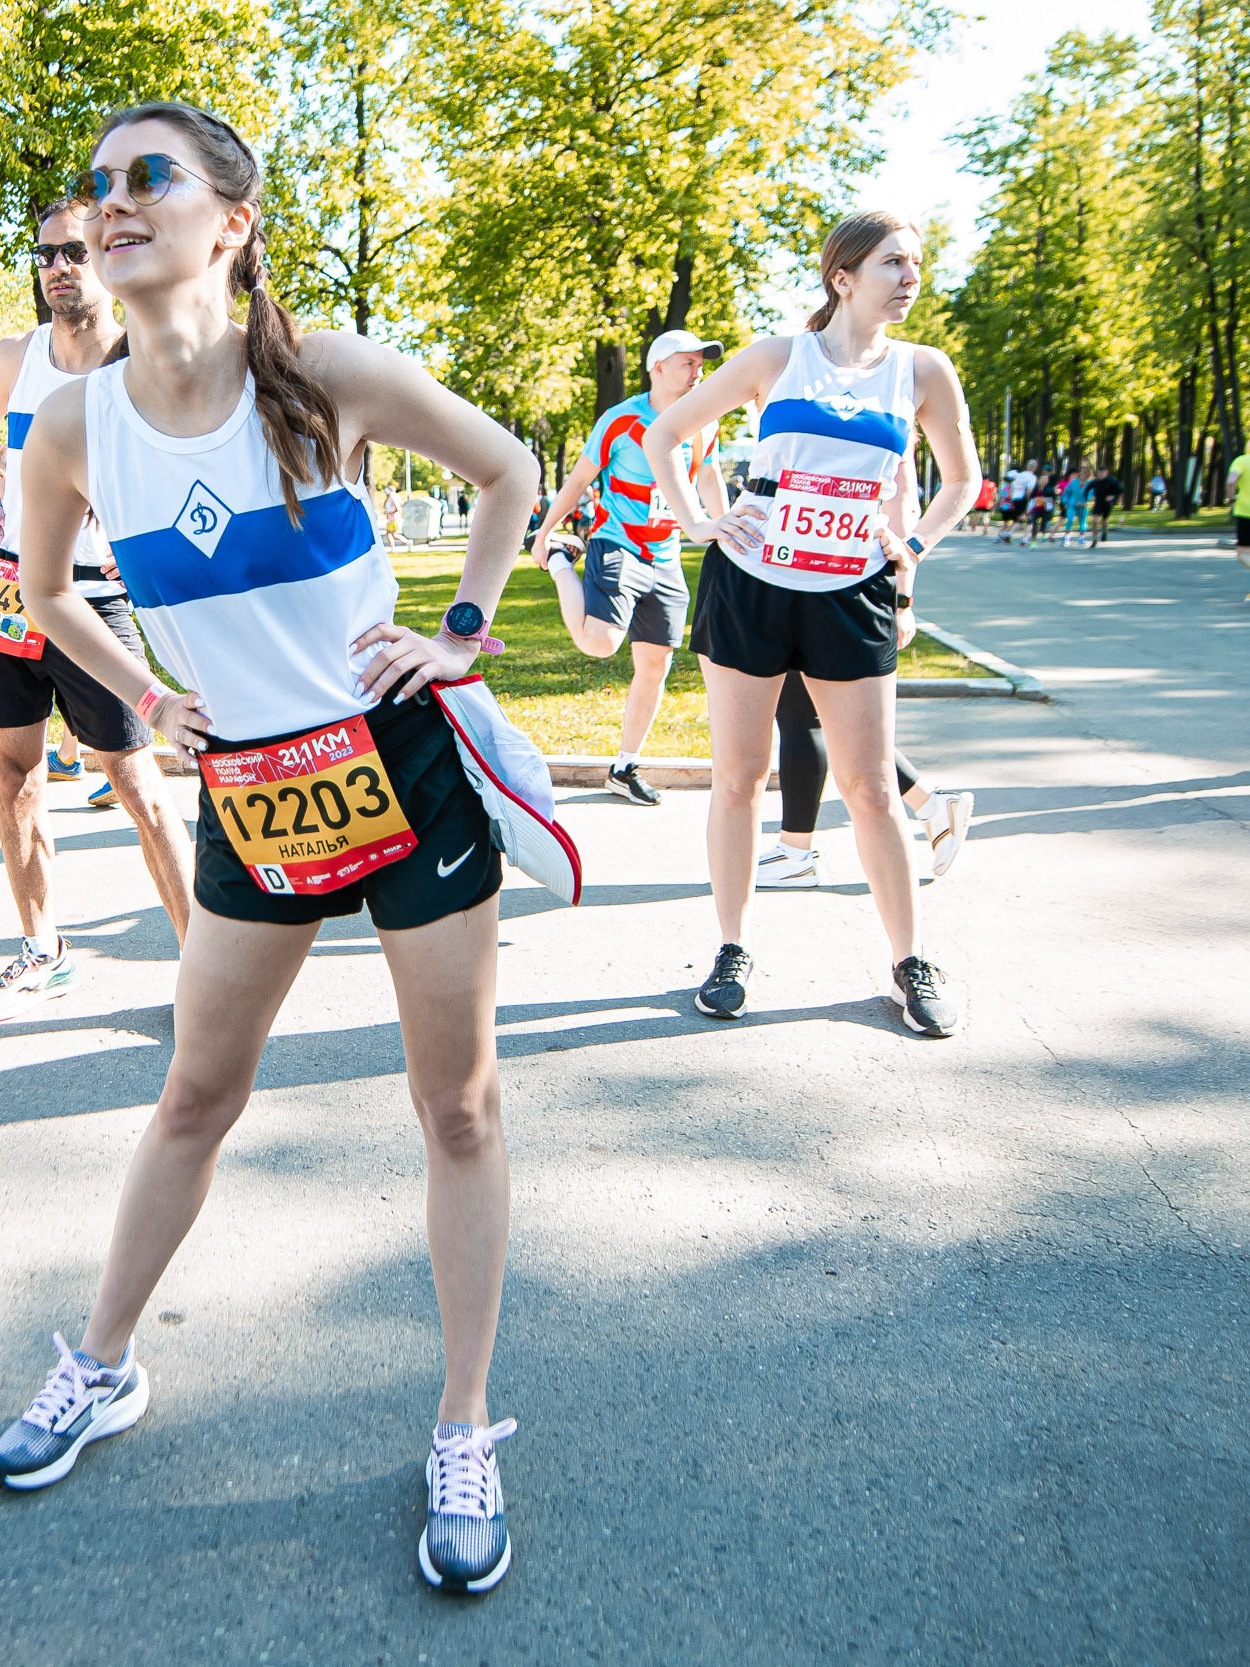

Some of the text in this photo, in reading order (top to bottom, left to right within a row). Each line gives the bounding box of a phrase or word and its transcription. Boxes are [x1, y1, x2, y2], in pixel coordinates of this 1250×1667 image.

[779, 504, 870, 542] 15384
[777, 546, 789, 561] G
[329, 746, 354, 762] 2023
[221, 765, 390, 842] 12203
[278, 835, 350, 858] НАТАЛЬЯ
[263, 867, 285, 890] D
